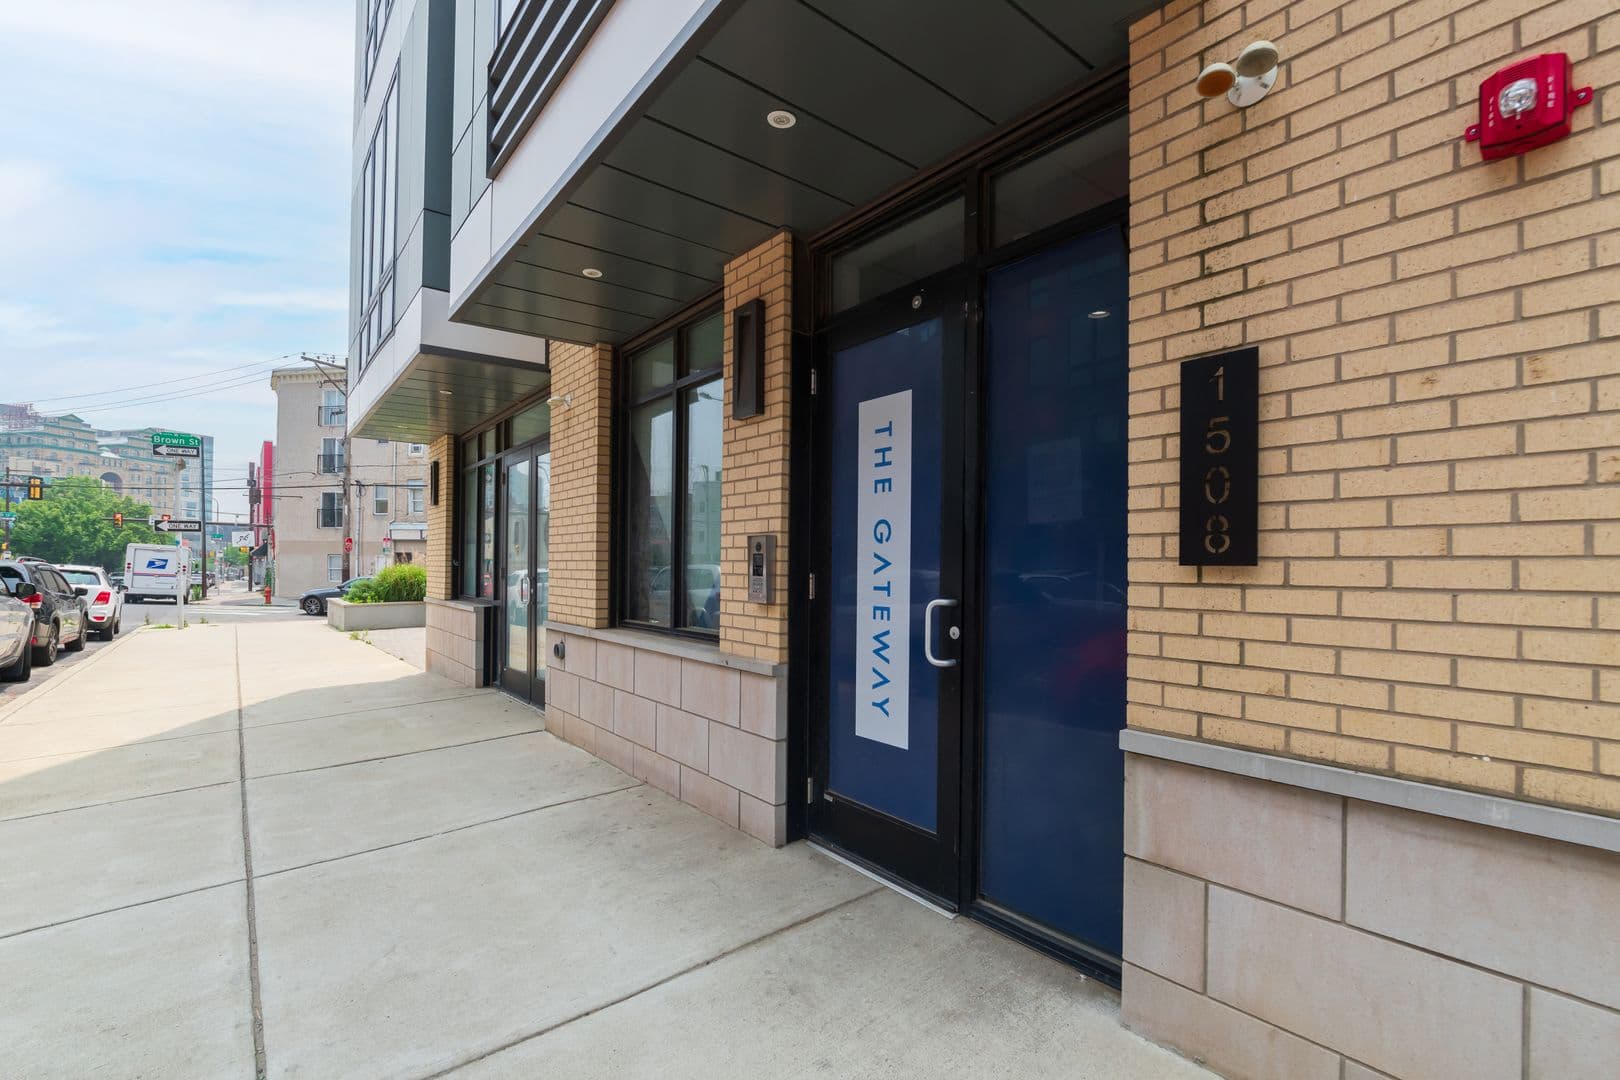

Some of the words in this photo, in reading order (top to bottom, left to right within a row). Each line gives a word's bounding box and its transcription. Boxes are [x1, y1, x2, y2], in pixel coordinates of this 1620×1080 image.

[153, 435, 185, 445] Brown
[189, 438, 199, 446] St
[873, 420, 893, 495] THE
[1204, 366, 1231, 554] 1508
[872, 518, 892, 718] GATEWAY
